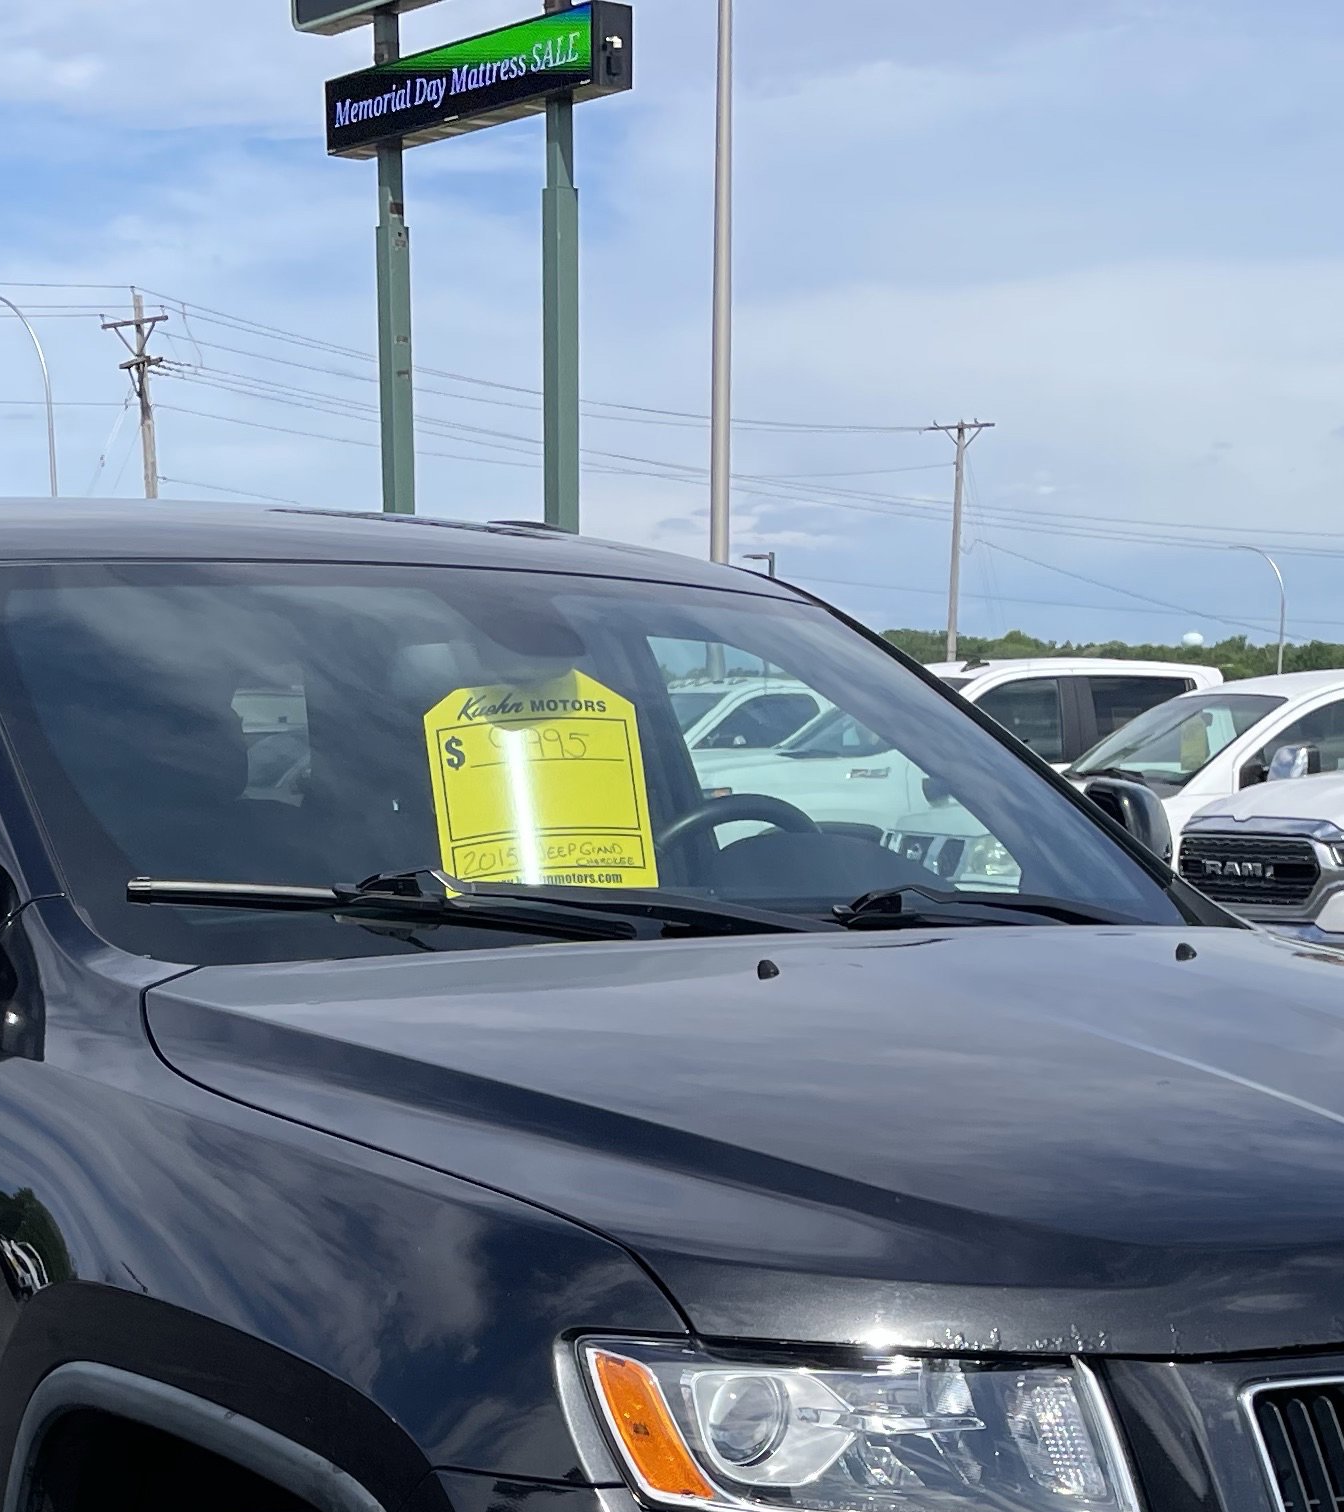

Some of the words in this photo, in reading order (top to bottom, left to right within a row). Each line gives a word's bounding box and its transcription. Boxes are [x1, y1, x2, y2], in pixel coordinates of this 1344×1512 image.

[334, 79, 412, 128] Memorial
[414, 77, 446, 109] Day
[450, 54, 527, 96] Mattress
[531, 31, 581, 73] SALE
[457, 692, 525, 721] Kuehn
[530, 698, 607, 713] MOTORS
[444, 735, 466, 770] $
[463, 847, 520, 876] 2015
[1202, 859, 1263, 877] RAM
